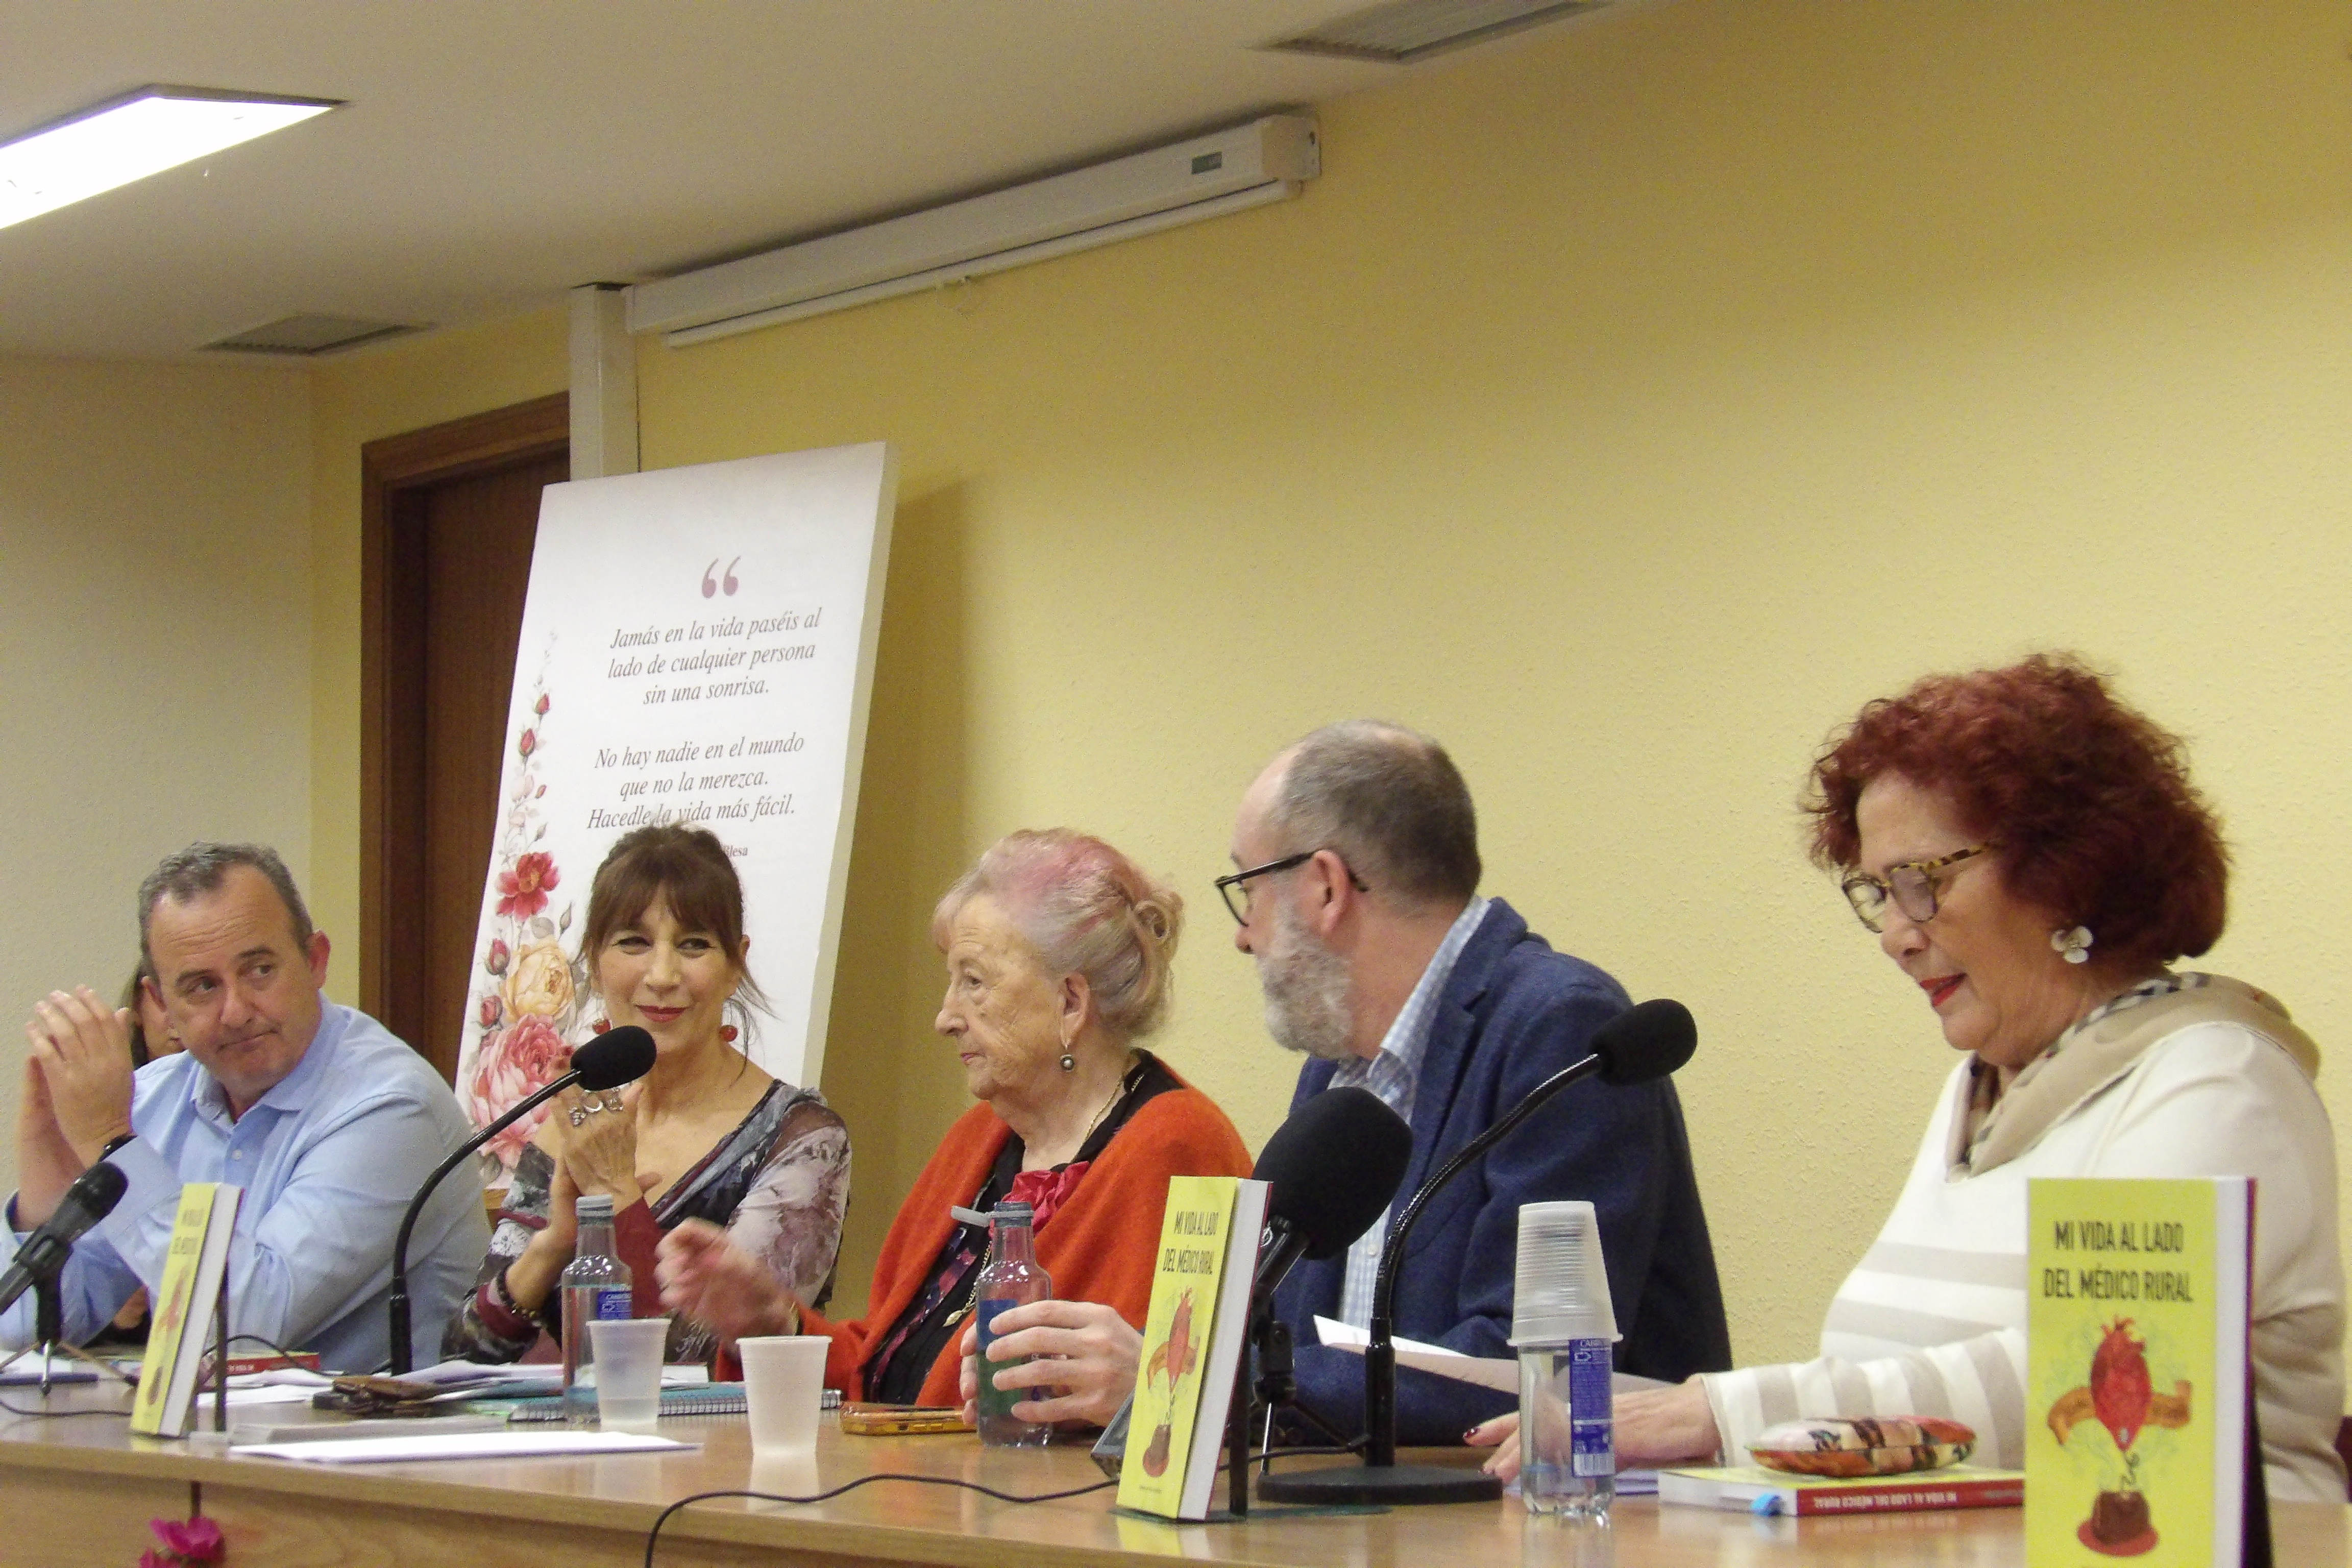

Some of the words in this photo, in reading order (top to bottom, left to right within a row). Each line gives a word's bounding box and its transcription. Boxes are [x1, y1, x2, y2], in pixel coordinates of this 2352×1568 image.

[610, 625, 660, 649] Jamás
[665, 627, 684, 643] en
[689, 620, 705, 641] la
[711, 616, 744, 638] vida
[746, 610, 799, 640] paséis
[804, 607, 822, 628] al
[608, 656, 643, 679] lado
[647, 653, 666, 674] de
[671, 647, 747, 674] cualquier
[748, 644, 816, 670] persona
[643, 684, 666, 704] sin
[671, 685, 701, 702] una
[706, 675, 769, 699] sonrisa.
[594, 748, 617, 768] No
[622, 746, 651, 770] hay
[654, 741, 700, 763] nadie
[705, 743, 724, 760] en
[729, 736, 746, 757] el
[748, 731, 805, 755] mundo
[620, 780, 648, 802] que
[653, 778, 673, 793] no
[678, 771, 695, 792] la
[699, 771, 768, 790] merezca.
[587, 804, 651, 829] Hacedle
[654, 803, 672, 824] la
[678, 800, 712, 821] vida
[716, 797, 750, 819] más
[749, 793, 795, 822] fácil.
[2054, 1220, 2074, 1251] MI
[2079, 1220, 2116, 1251] VIDA
[2120, 1221, 2139, 1252] AL
[2143, 1221, 2184, 1253] LADO
[1163, 1248, 1176, 1271] DEL
[2043, 1267, 2074, 1299] DEL
[2079, 1262, 2140, 1301] MÉDICO
[2143, 1269, 2194, 1303] RURAL
